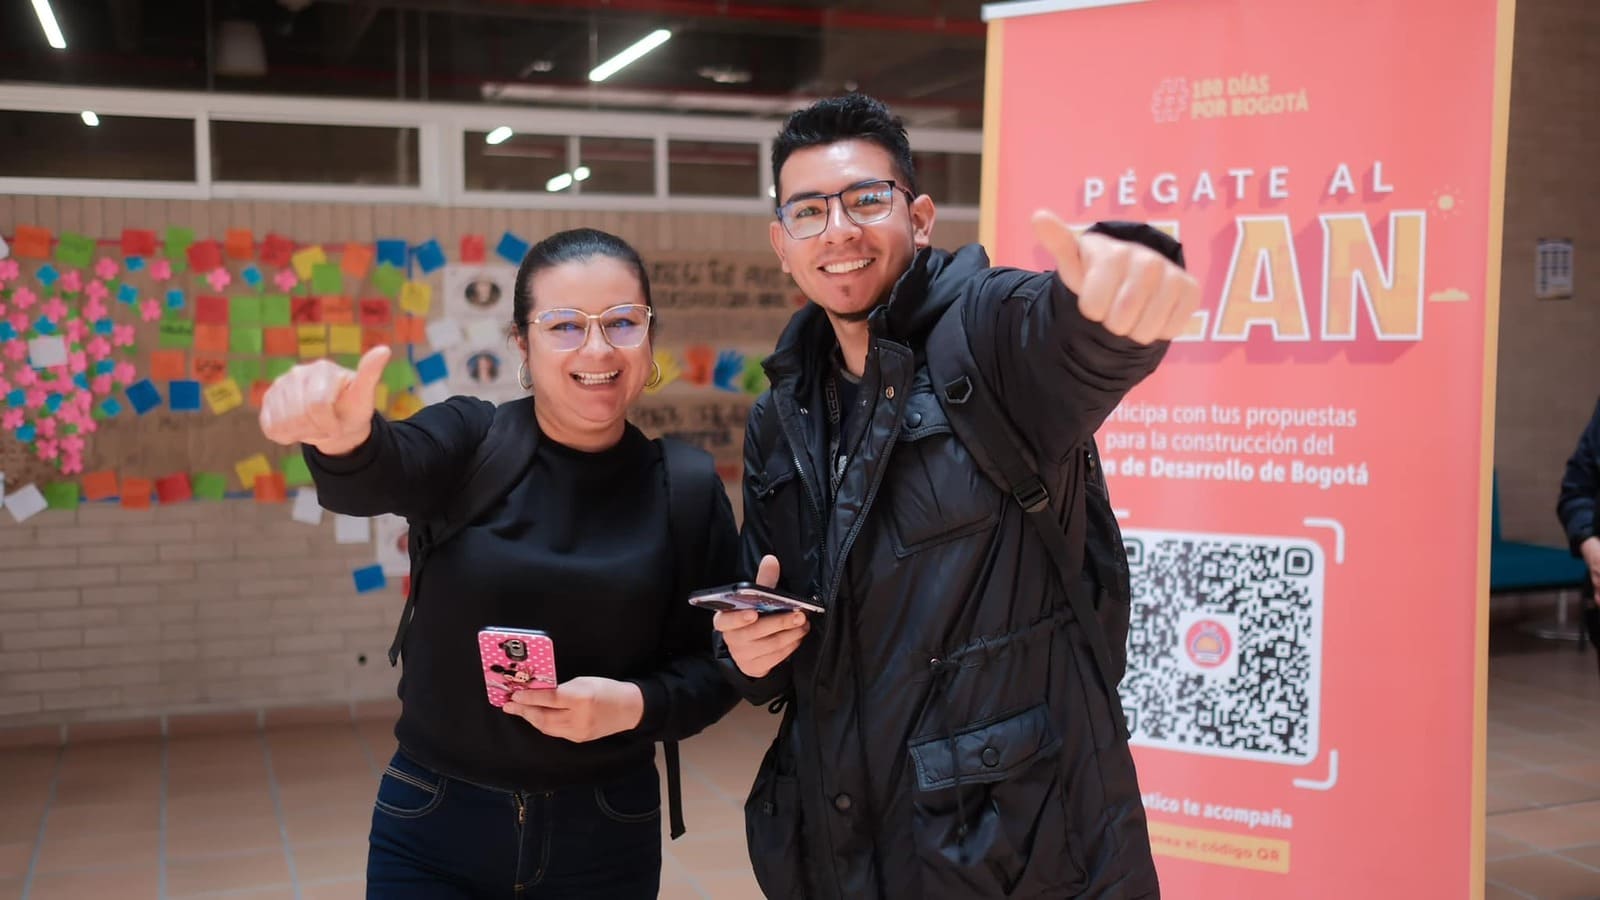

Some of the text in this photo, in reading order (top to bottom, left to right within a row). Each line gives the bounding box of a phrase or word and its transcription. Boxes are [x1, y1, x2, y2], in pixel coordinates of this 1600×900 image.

[1228, 72, 1269, 96] DÍAS
[1191, 88, 1309, 119] POR BOGOTÁ
[1084, 161, 1394, 207] PÉGATE AL
[1066, 211, 1426, 343] AN
[1172, 406, 1207, 423] con
[1211, 404, 1240, 424] tus
[1246, 405, 1357, 430] propuestas
[1105, 430, 1334, 455] para la construcción del
[1121, 456, 1145, 476] de
[1151, 456, 1254, 482] Desarrollo
[1260, 460, 1285, 483] de
[1291, 461, 1370, 489] Bogotá
[1184, 798, 1199, 816] te
[1204, 803, 1293, 829] acompaña
